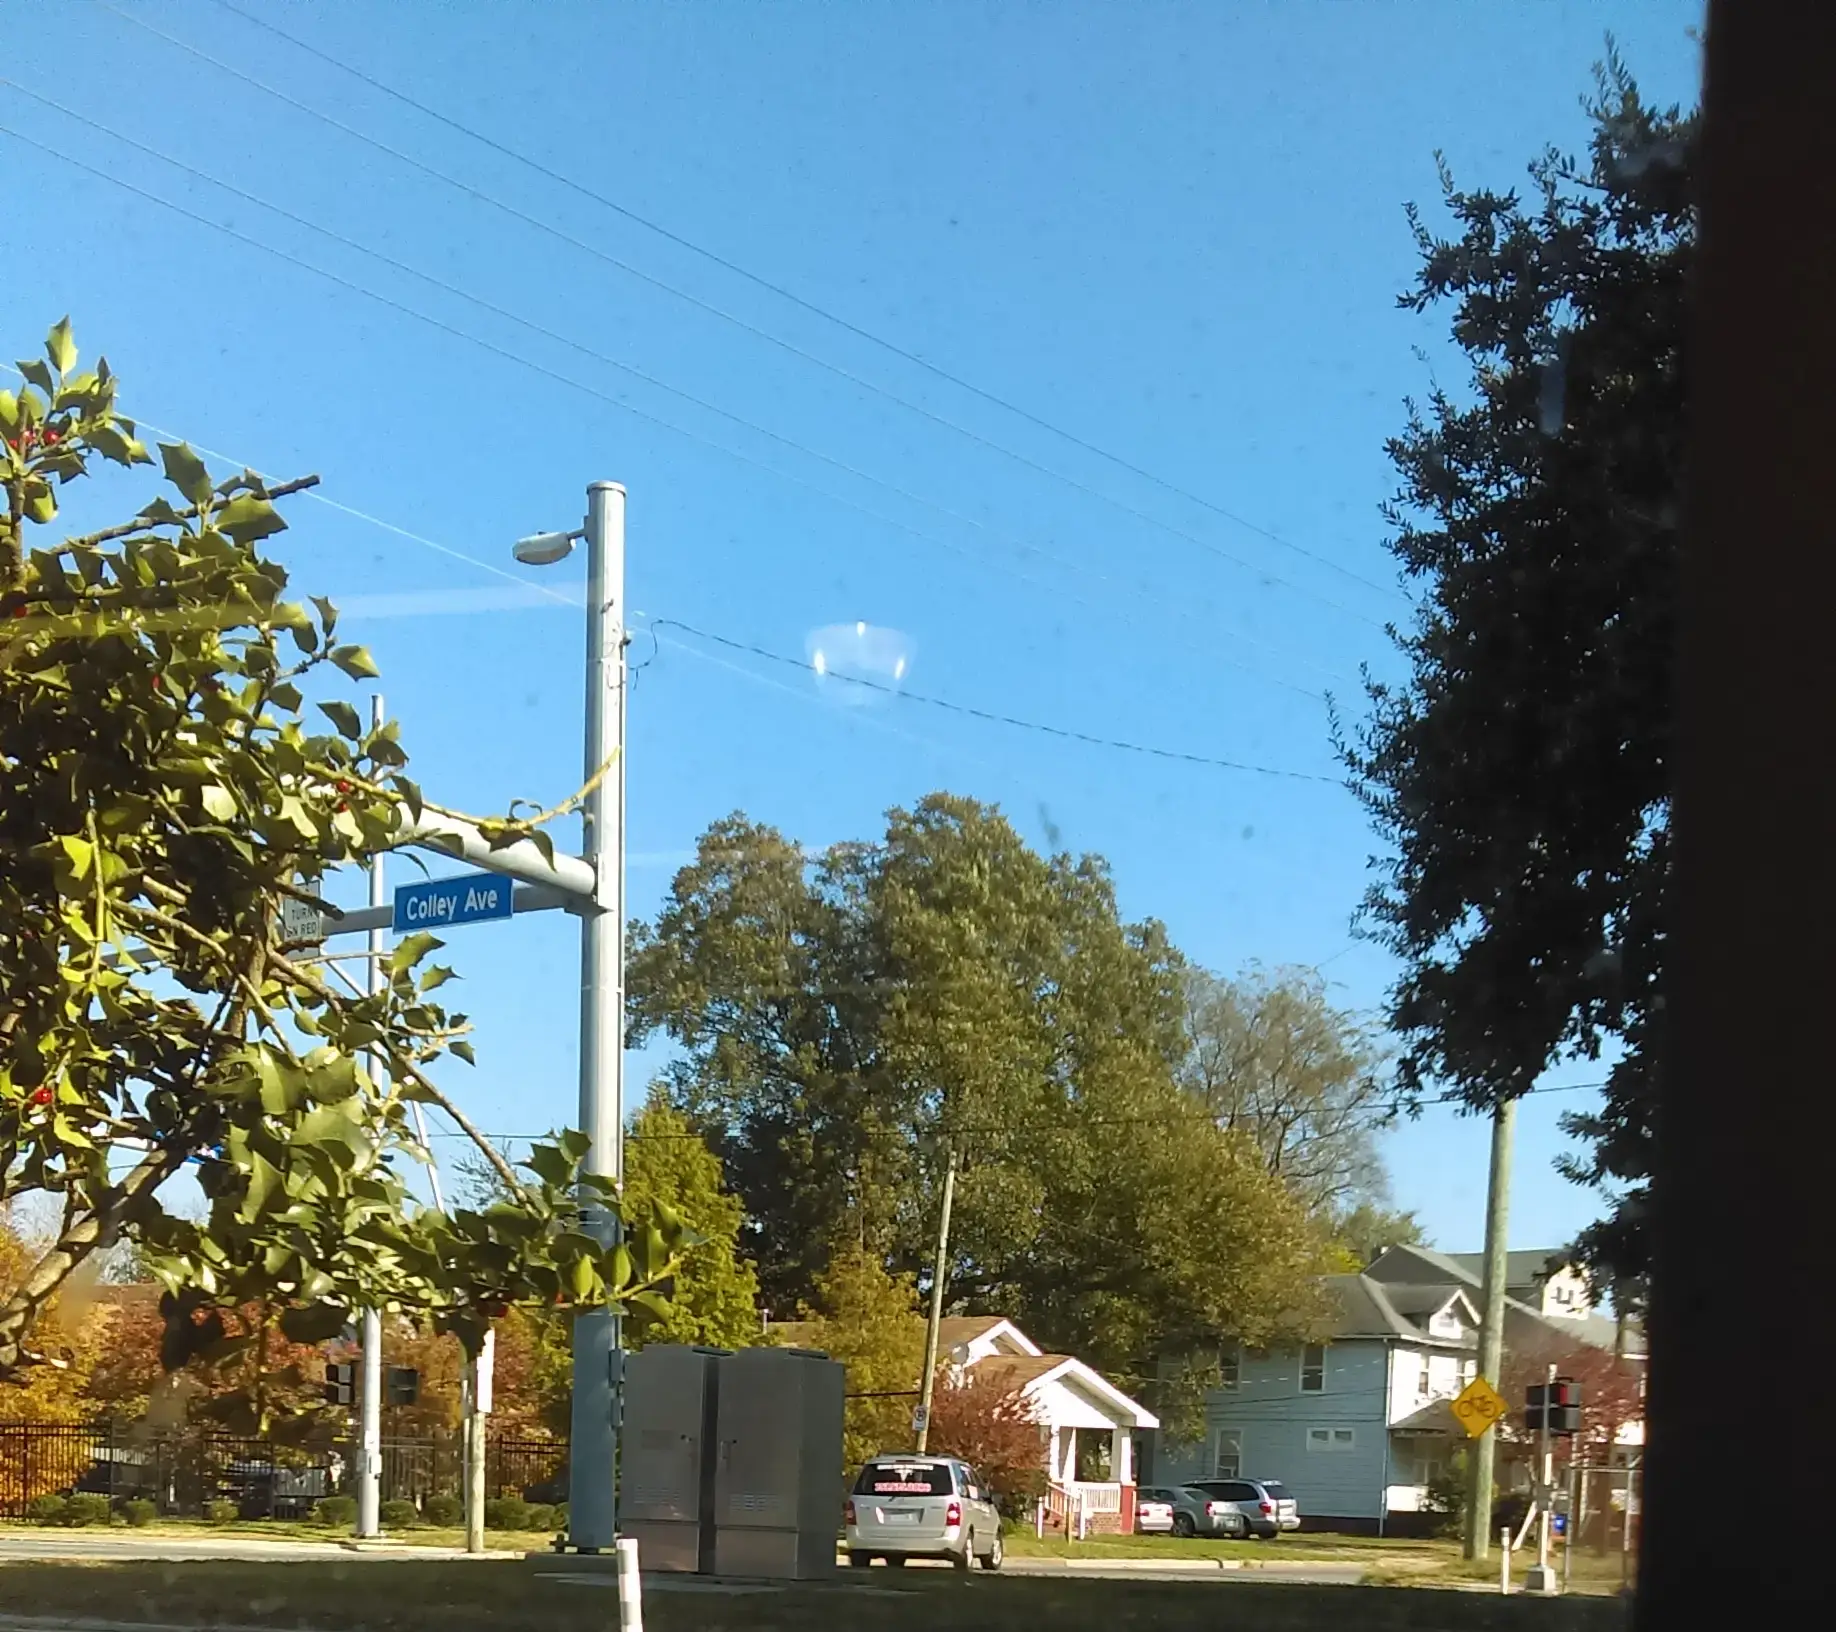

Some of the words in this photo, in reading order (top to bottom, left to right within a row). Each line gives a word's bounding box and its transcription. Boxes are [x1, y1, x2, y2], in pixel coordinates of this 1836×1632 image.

[406, 893, 458, 921] Colley
[464, 886, 498, 913] Ave
[291, 905, 313, 921] TURN
[301, 921, 317, 936] RED
